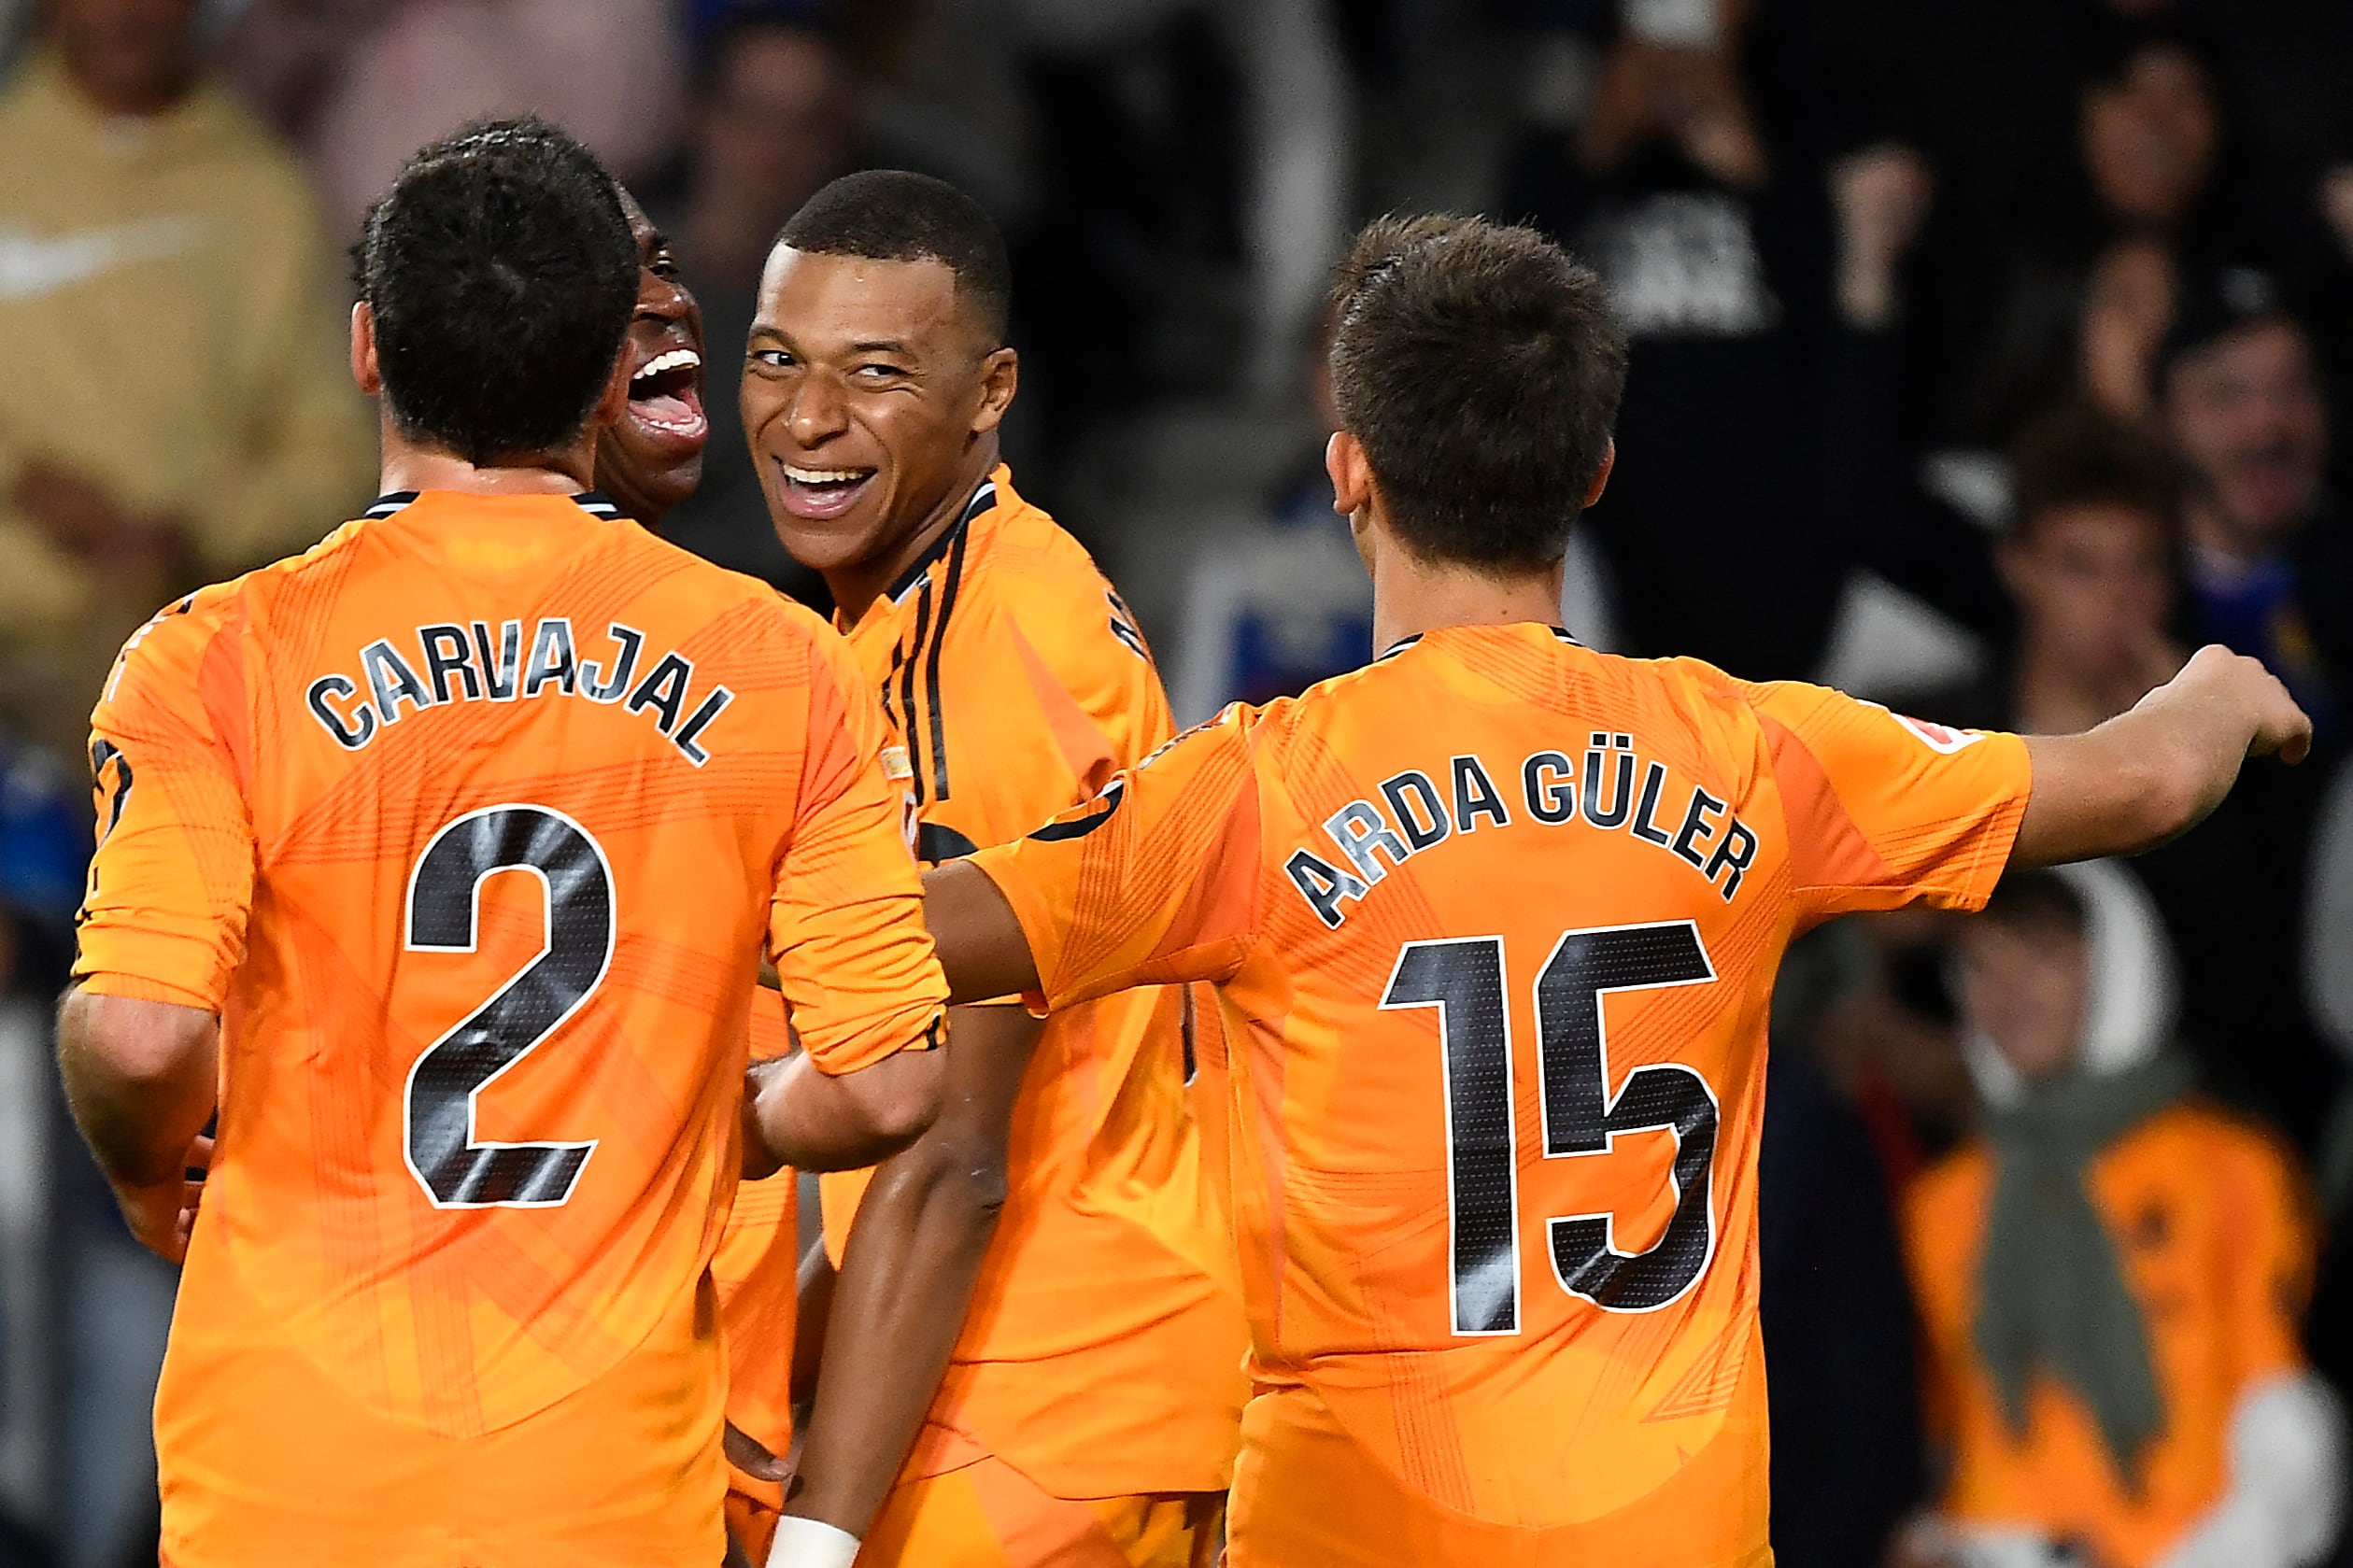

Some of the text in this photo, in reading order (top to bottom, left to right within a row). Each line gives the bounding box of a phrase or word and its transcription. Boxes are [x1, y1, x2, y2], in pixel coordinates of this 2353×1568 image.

[305, 616, 736, 768] CARVAJAL
[1283, 730, 1761, 930] ARDA GÜLER
[403, 802, 617, 1209] 2
[1377, 918, 1721, 1338] 15
